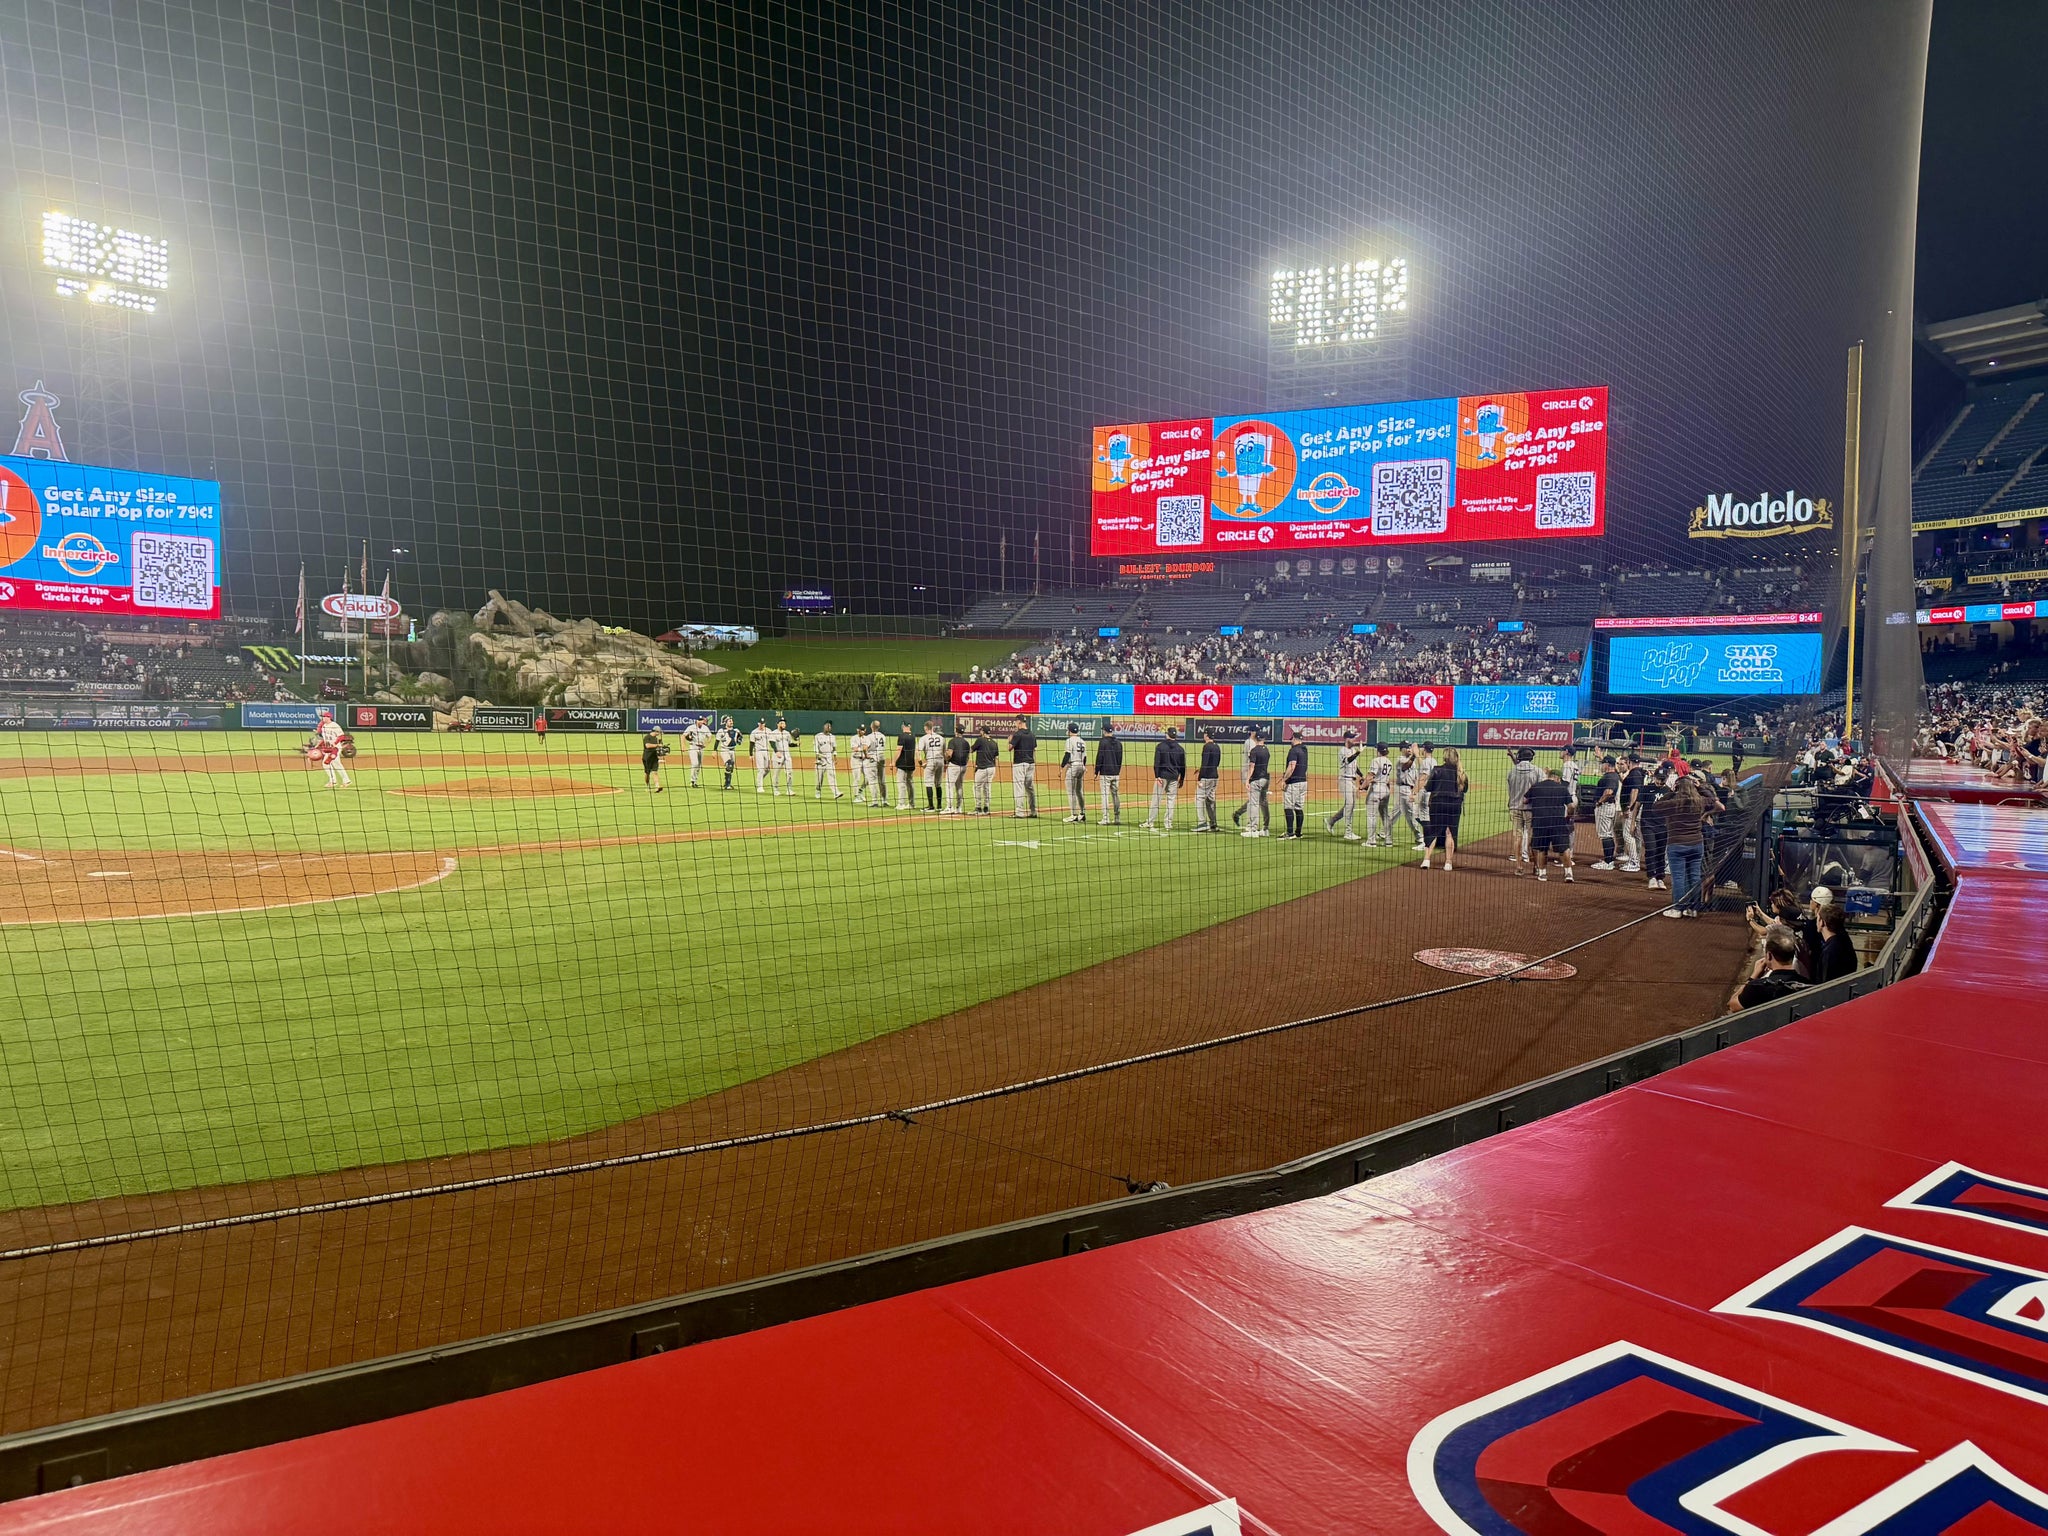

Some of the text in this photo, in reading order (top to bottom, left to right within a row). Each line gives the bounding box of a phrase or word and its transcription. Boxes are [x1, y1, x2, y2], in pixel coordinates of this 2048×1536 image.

[1541, 397, 1592, 410] CIRCLE K
[1160, 428, 1201, 440] CIRCLE K
[1300, 417, 1415, 446] Get Any Size
[1504, 420, 1604, 445] Get Any Size
[1302, 445, 1345, 461] Polar
[1349, 437, 1382, 456] Pop
[1386, 433, 1412, 447] for
[1505, 438, 1576, 458] Polar Pop
[1130, 448, 1210, 470] Get Any Size
[1504, 459, 1527, 471] for
[1131, 465, 1188, 482] Polar Pop
[1131, 481, 1149, 494] for
[44, 486, 177, 505] Get Any Size
[1462, 496, 1518, 505] Download The
[46, 503, 101, 517] Polar
[105, 505, 142, 521] Pop
[146, 505, 173, 519] for
[1466, 504, 1487, 513] Circle
[1496, 504, 1512, 512] App
[1707, 490, 1813, 527] Modelo
[1098, 516, 1129, 524] Download
[1959, 514, 1998, 525] RESTAURANT
[1126, 522, 1139, 531] App
[1289, 522, 1350, 531] Download The
[1216, 528, 1273, 542] CIRCLE K
[1294, 531, 1317, 539] Circle
[1326, 531, 1345, 540] App
[35, 584, 109, 596] Download The
[41, 593, 71, 602] Circle
[82, 596, 104, 605] App
[336, 599, 391, 614] Yakult
[244, 616, 269, 624] STORE
[1799, 613, 1818, 622] 9:41
[1641, 641, 1692, 672] Polar
[1724, 644, 1778, 658] STAYS
[1729, 656, 1773, 669] COLD
[1717, 669, 1783, 682] LONGER
[961, 690, 1025, 706] CIRCLE K
[1145, 691, 1217, 708] CIRCLE K
[1295, 690, 1322, 698] STAYS
[1470, 688, 1500, 706] Polar
[1526, 690, 1557, 700] STAYS
[1291, 702, 1324, 711] LONGER
[1298, 697, 1319, 705] COLD
[1353, 693, 1434, 710] CIRCLE K
[1529, 698, 1554, 706] COLD
[567, 710, 620, 720] YOKOHAMA
[1522, 705, 1560, 714] LONGER
[92, 719, 171, 727] 714TICKETS.COM
[380, 712, 427, 722] TOYOTA
[475, 716, 525, 725] REDIENTS
[595, 722, 620, 730] TIRES
[1114, 723, 1157, 733] Surfside
[1289, 724, 1362, 738] Yakult
[928, 737, 941, 747] 22
